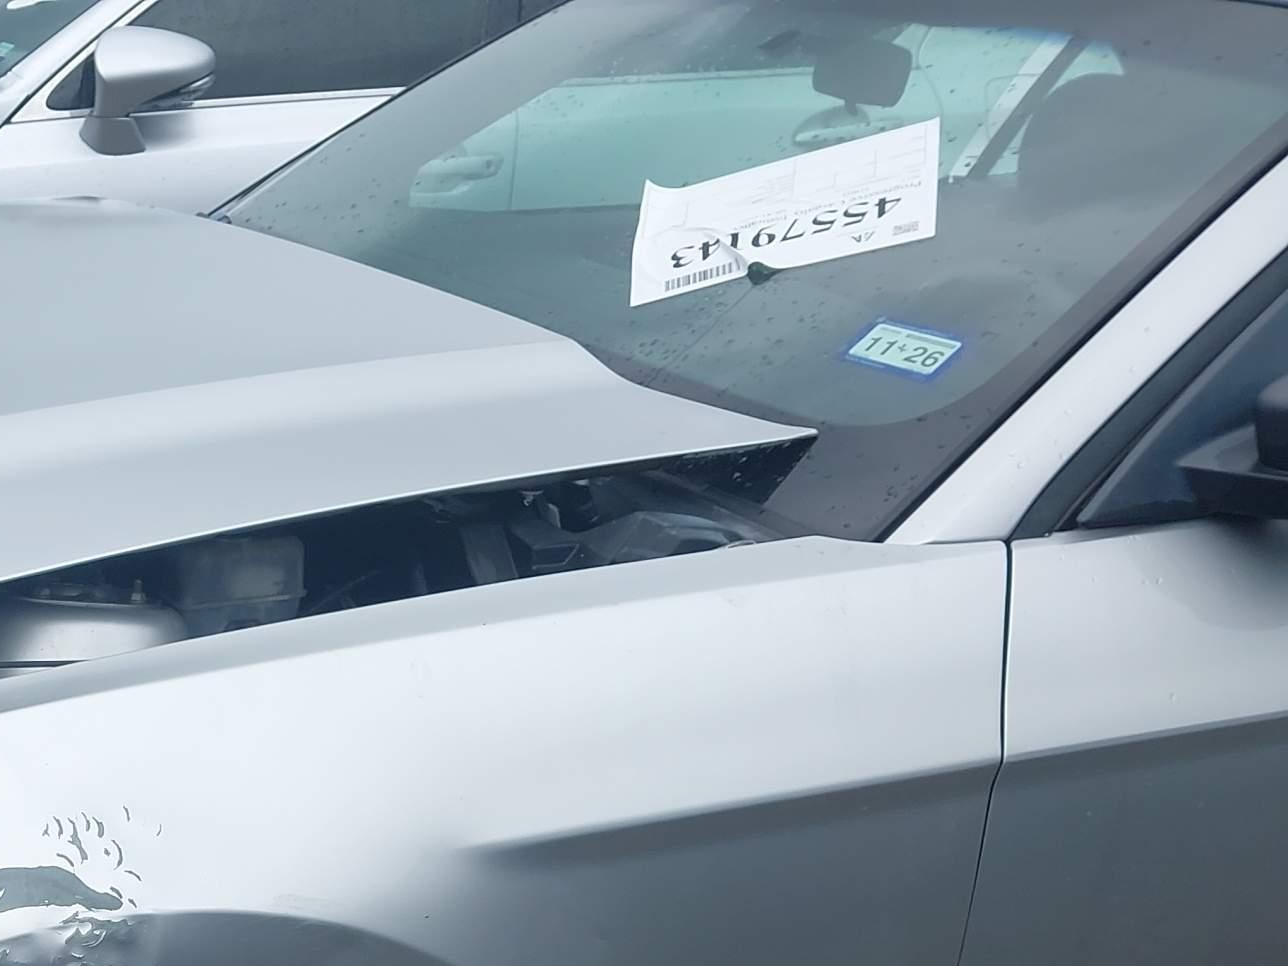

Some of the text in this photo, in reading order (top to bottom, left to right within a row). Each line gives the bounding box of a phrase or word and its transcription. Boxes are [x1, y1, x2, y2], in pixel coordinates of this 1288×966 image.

[670, 196, 902, 269] 45579143
[864, 336, 899, 356] 11
[903, 346, 945, 368] 26
